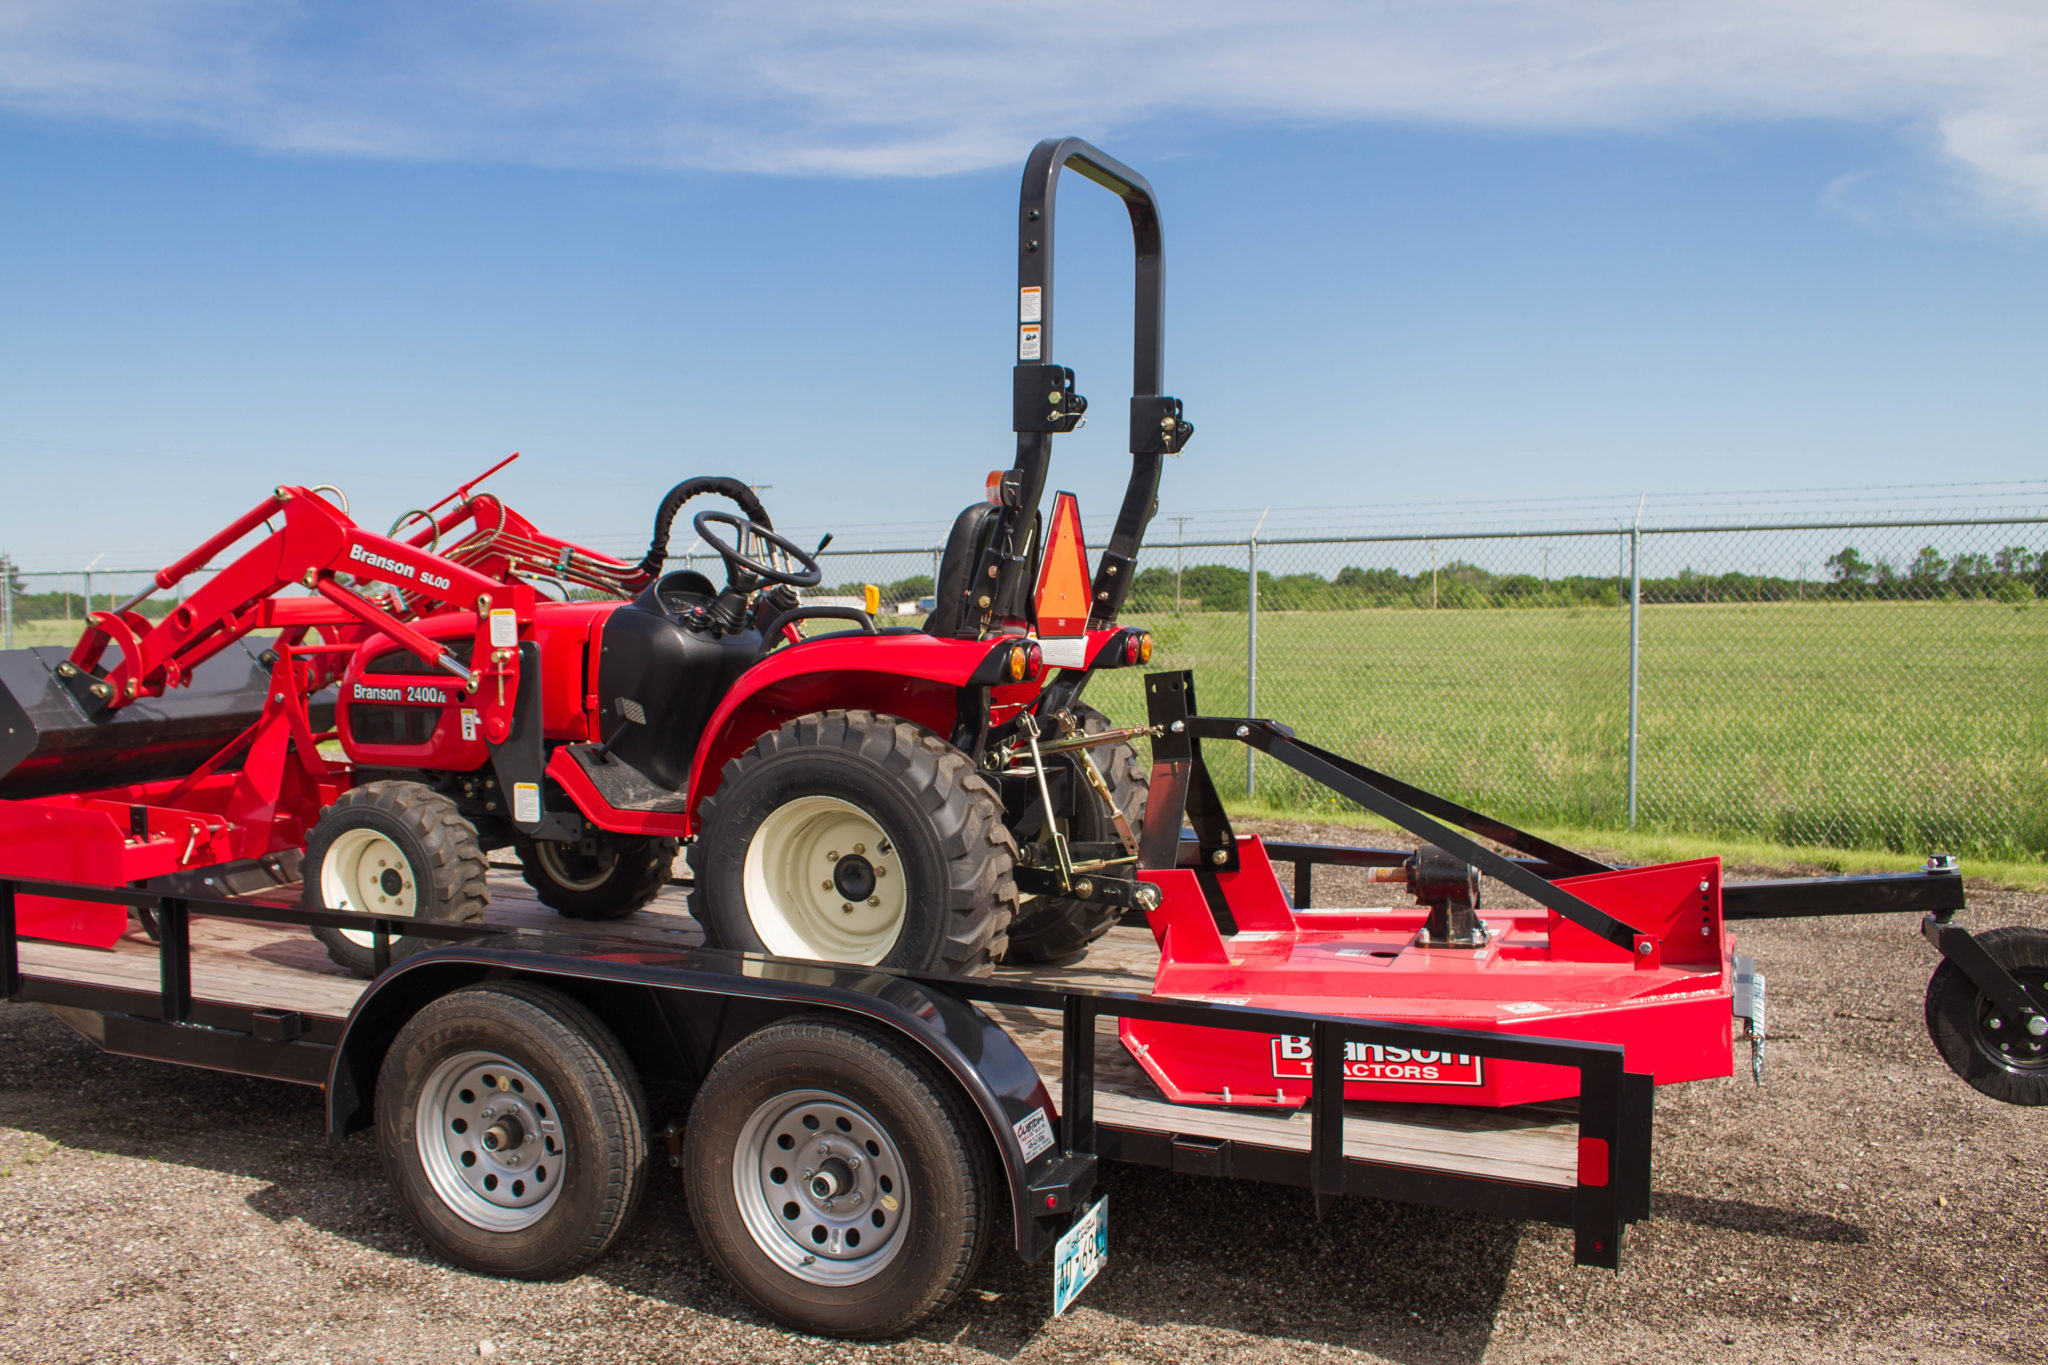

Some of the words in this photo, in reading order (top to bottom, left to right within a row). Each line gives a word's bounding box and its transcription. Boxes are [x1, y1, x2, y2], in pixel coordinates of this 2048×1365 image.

[349, 543, 415, 578] Branson
[353, 683, 402, 702] Branson
[1280, 1034, 1471, 1065] Bnson
[1301, 1061, 1439, 1080] TCTORS
